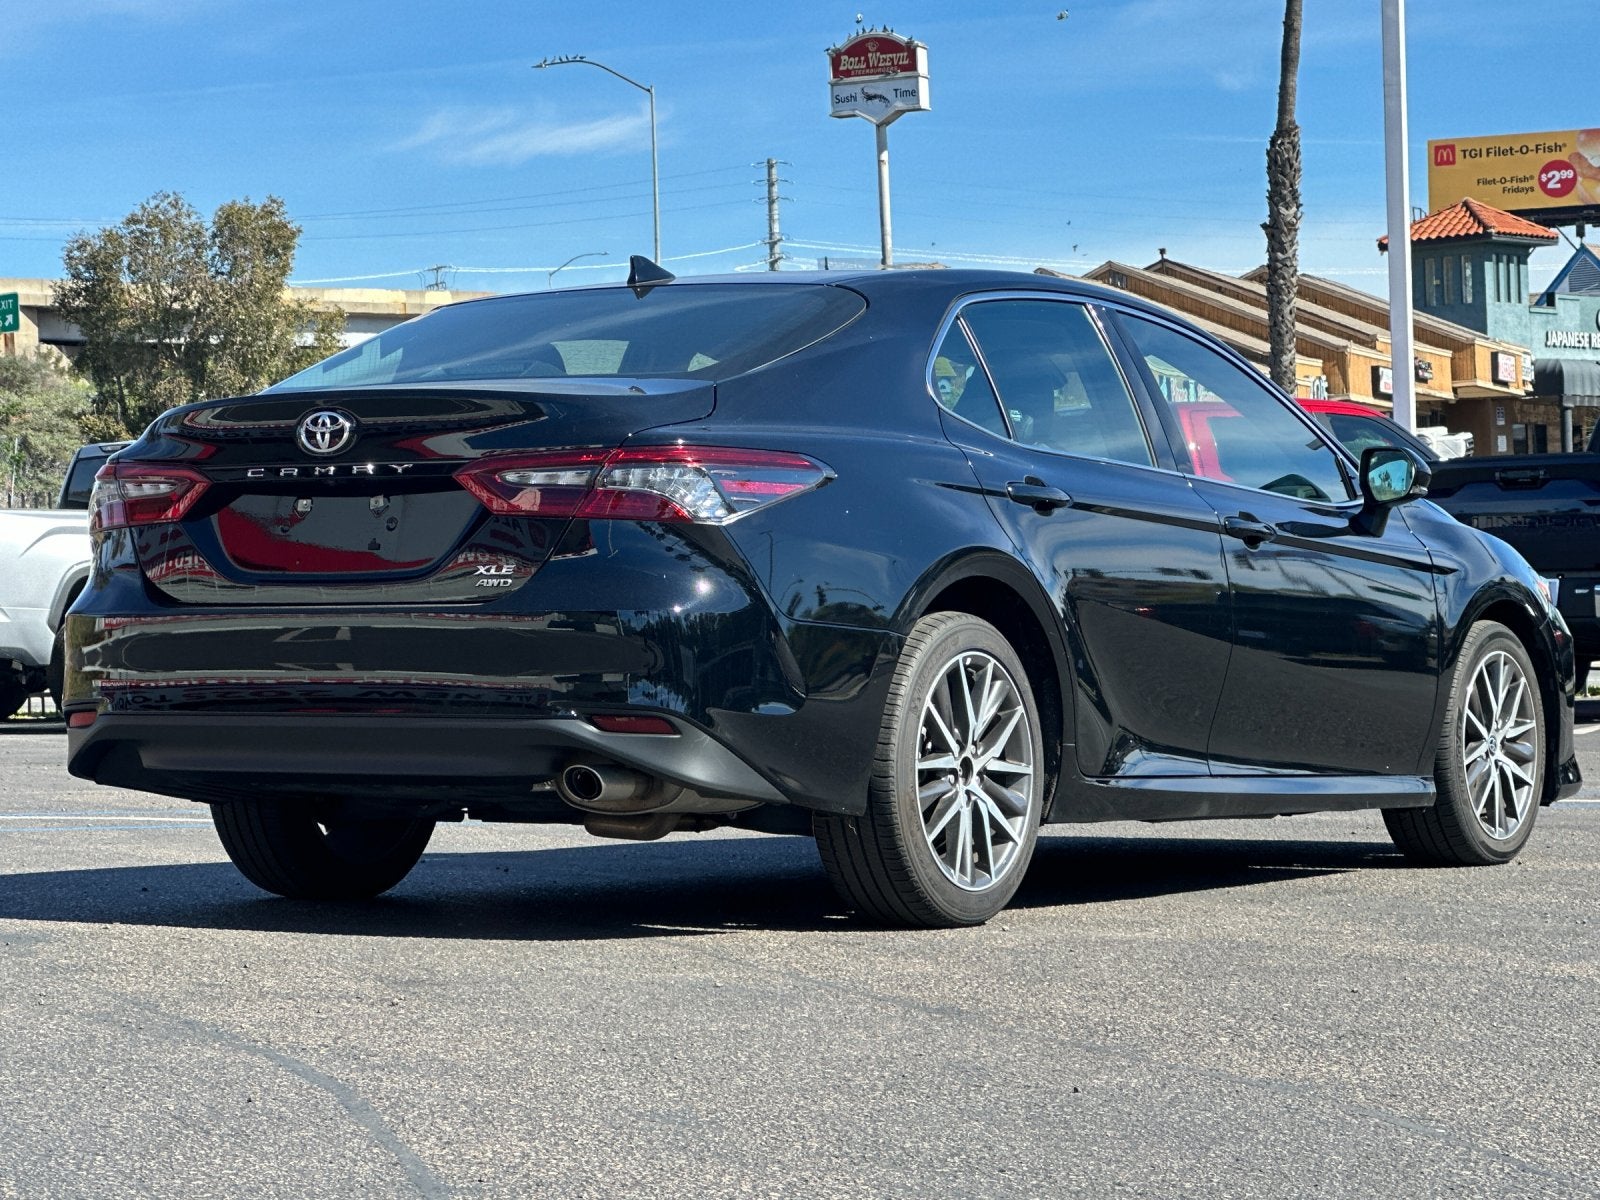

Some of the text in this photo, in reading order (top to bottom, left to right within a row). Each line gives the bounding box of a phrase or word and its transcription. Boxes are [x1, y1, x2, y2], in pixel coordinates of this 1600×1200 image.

[868, 52, 909, 67] WEEVIL
[835, 88, 917, 104] Sushi Time
[1461, 148, 1482, 159] TGI
[1502, 186, 1535, 195] Fridays
[0, 299, 13, 310] XIT
[1546, 330, 1589, 348] JAPANESE
[247, 463, 413, 477] CAMRY
[473, 564, 516, 575] XLE
[475, 578, 513, 587] AWD
